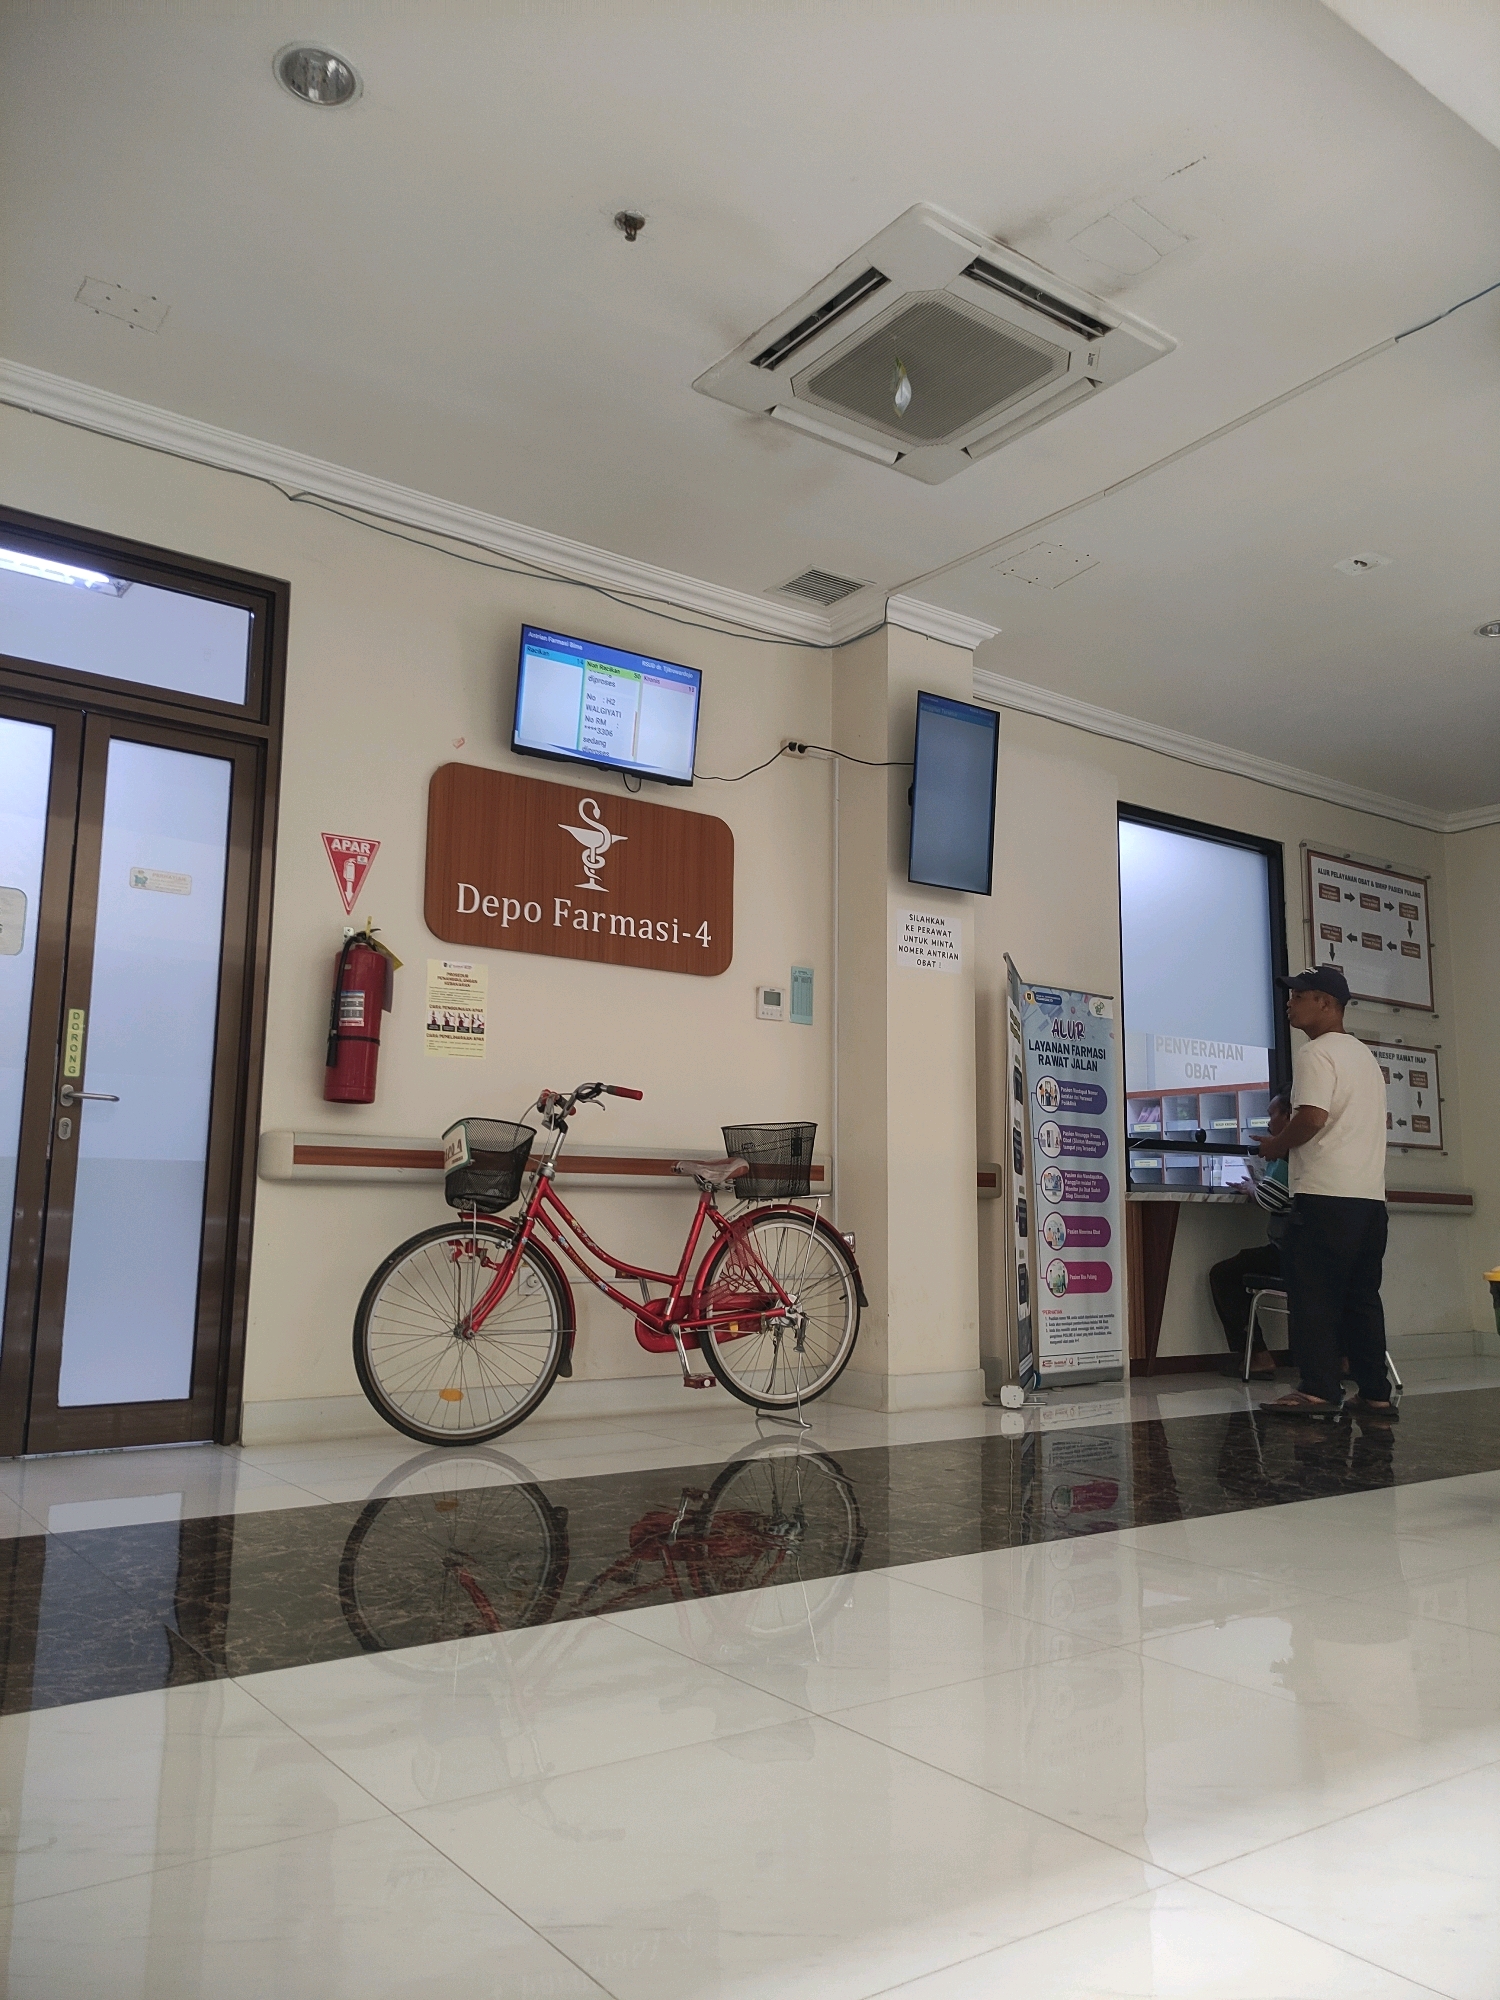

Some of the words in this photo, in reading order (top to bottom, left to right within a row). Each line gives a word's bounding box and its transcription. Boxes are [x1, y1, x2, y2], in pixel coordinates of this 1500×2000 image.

[548, 636, 569, 647] Farmasi
[527, 646, 550, 656] Racikan
[587, 661, 598, 669] Non
[599, 664, 620, 674] Racikan
[588, 675, 616, 688] diproses
[644, 676, 660, 684] Kronis
[587, 693, 596, 701] No
[606, 697, 616, 705] H2
[586, 704, 622, 718] WALGIYATI
[585, 715, 594, 723] No
[596, 717, 606, 726] RM
[583, 737, 606, 748] sedang
[331, 839, 371, 854] APAR
[1318, 867, 1330, 877] ALUR
[1331, 870, 1357, 883] PELAYANAN
[1358, 878, 1370, 887] OBAT
[1388, 885, 1404, 894] PASIEN
[1404, 889, 1421, 898] PULANG
[456, 882, 542, 928] Depo
[552, 897, 712, 948] Farmasi-4
[909, 914, 945, 926] SILAHKAN
[906, 924, 914, 932] KE
[918, 926, 952, 938] PERAWAT
[904, 935, 928, 945] UNTUK
[931, 939, 954, 949] MINTA
[898, 945, 924, 955] NOMER
[927, 950, 958, 960] ANTRIAN
[916, 959, 936, 967] OBAT
[1051, 1018, 1086, 1040] ALUR
[68, 1012, 80, 1074] DORONG
[1028, 1039, 1070, 1055] LAYANAN
[1072, 1044, 1106, 1060] FARMASI
[1156, 1036, 1244, 1061] PENYERAHAN
[1038, 1054, 1069, 1068] RAWAT
[1071, 1059, 1098, 1072] JALAN
[1379, 1051, 1395, 1060] RESEP
[1396, 1053, 1413, 1062] RAWAT
[1415, 1056, 1426, 1064] INAP
[1185, 1062, 1217, 1080] OBAT
